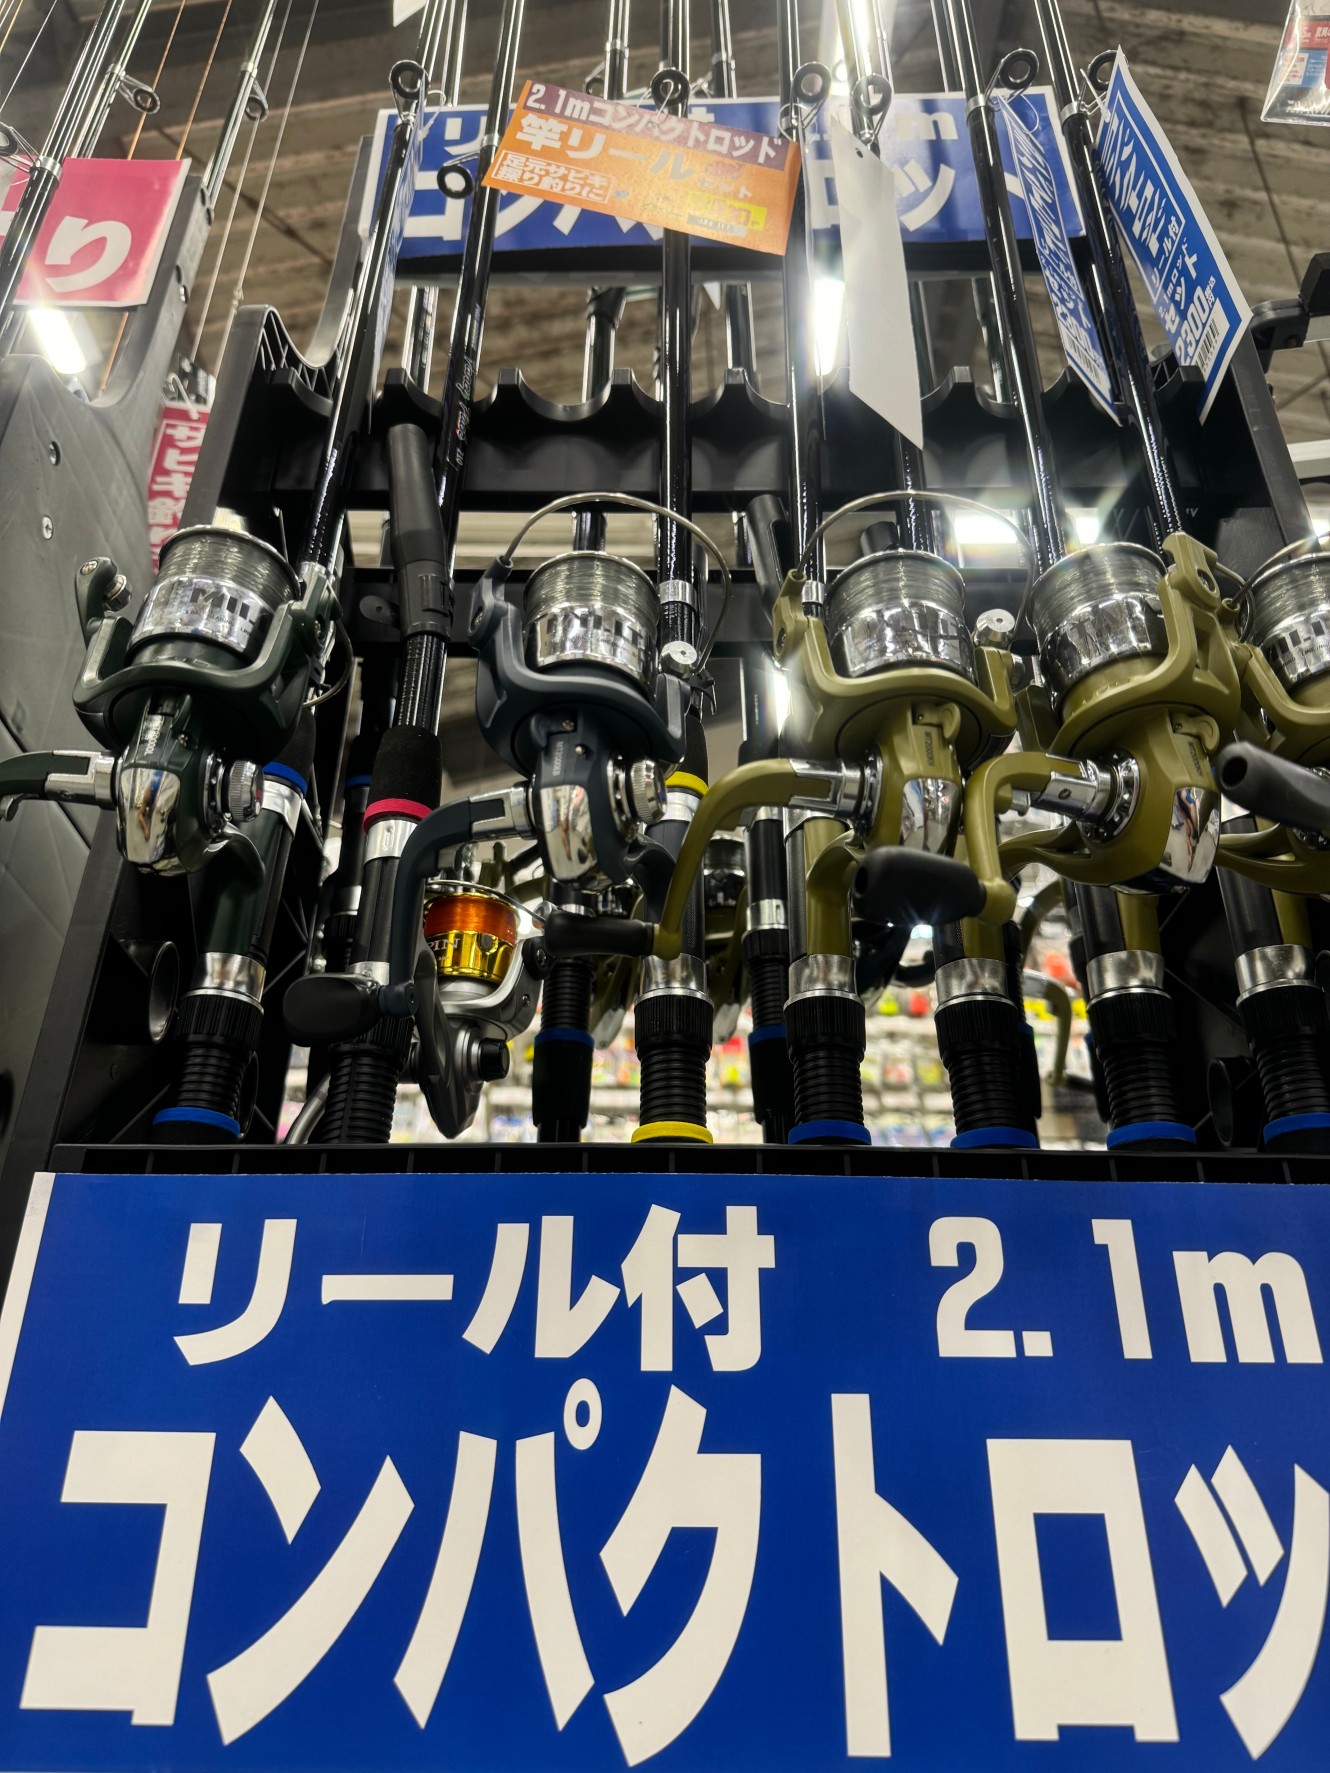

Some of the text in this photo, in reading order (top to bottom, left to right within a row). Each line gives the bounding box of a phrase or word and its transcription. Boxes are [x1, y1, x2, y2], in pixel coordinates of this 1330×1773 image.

[515, 113, 696, 181] 竿リール
[1151, 215, 1180, 289] リール付
[1164, 252, 1198, 335] セット
[173, 1203, 776, 1372] リール付
[18, 1378, 1330, 1767] コンパクトロッ
